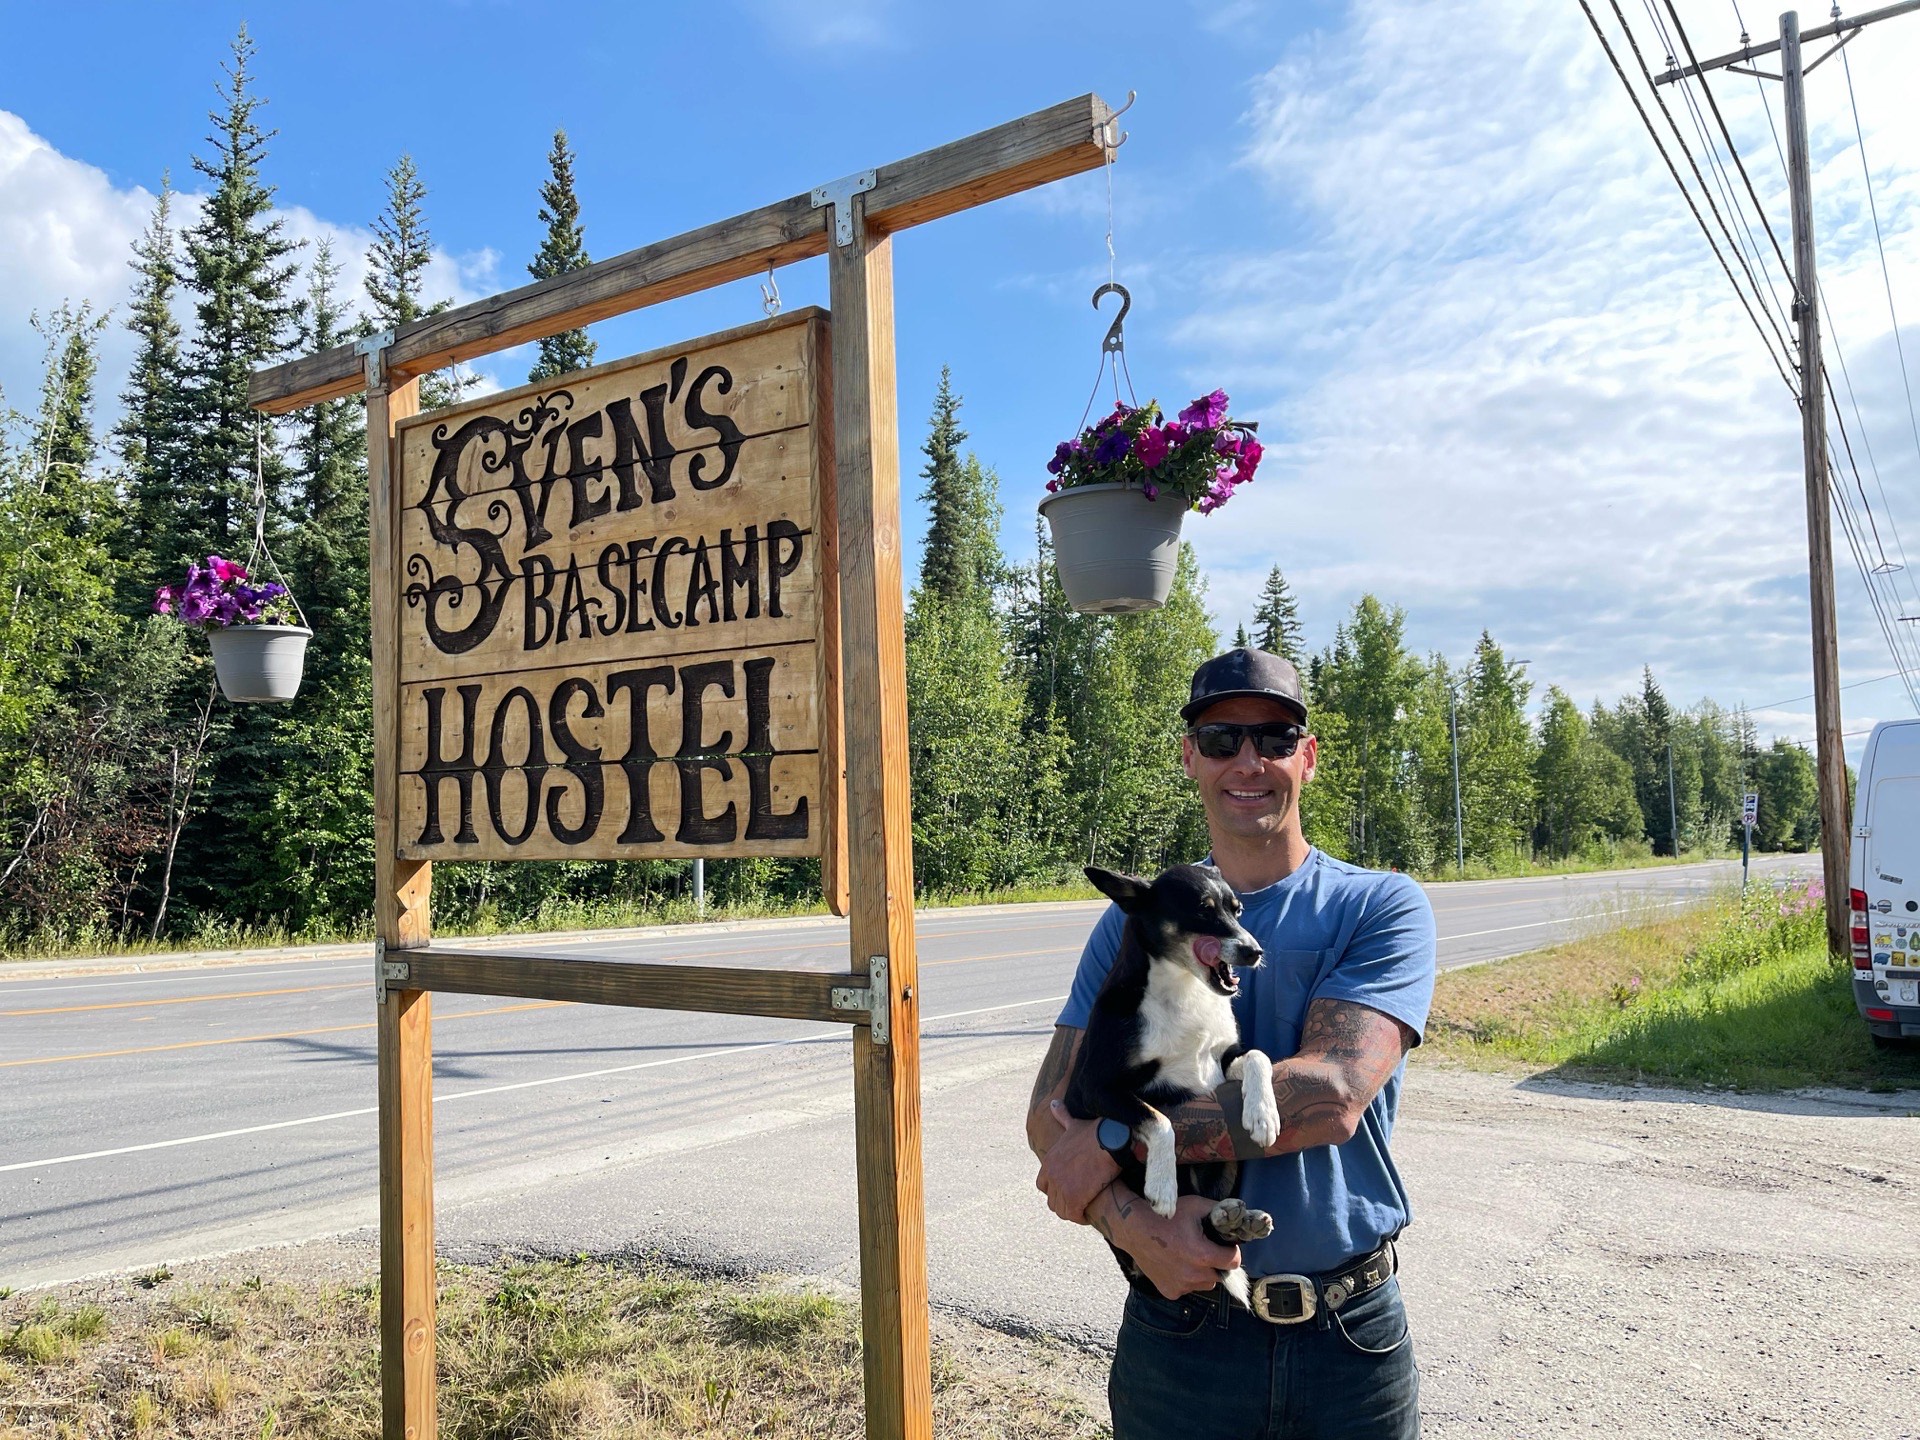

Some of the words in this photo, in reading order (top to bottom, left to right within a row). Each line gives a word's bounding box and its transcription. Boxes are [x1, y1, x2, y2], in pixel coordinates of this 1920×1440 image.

[407, 356, 748, 654] SVEN'S
[518, 520, 803, 651] BASECAMP
[417, 657, 809, 845] HOSTEL
